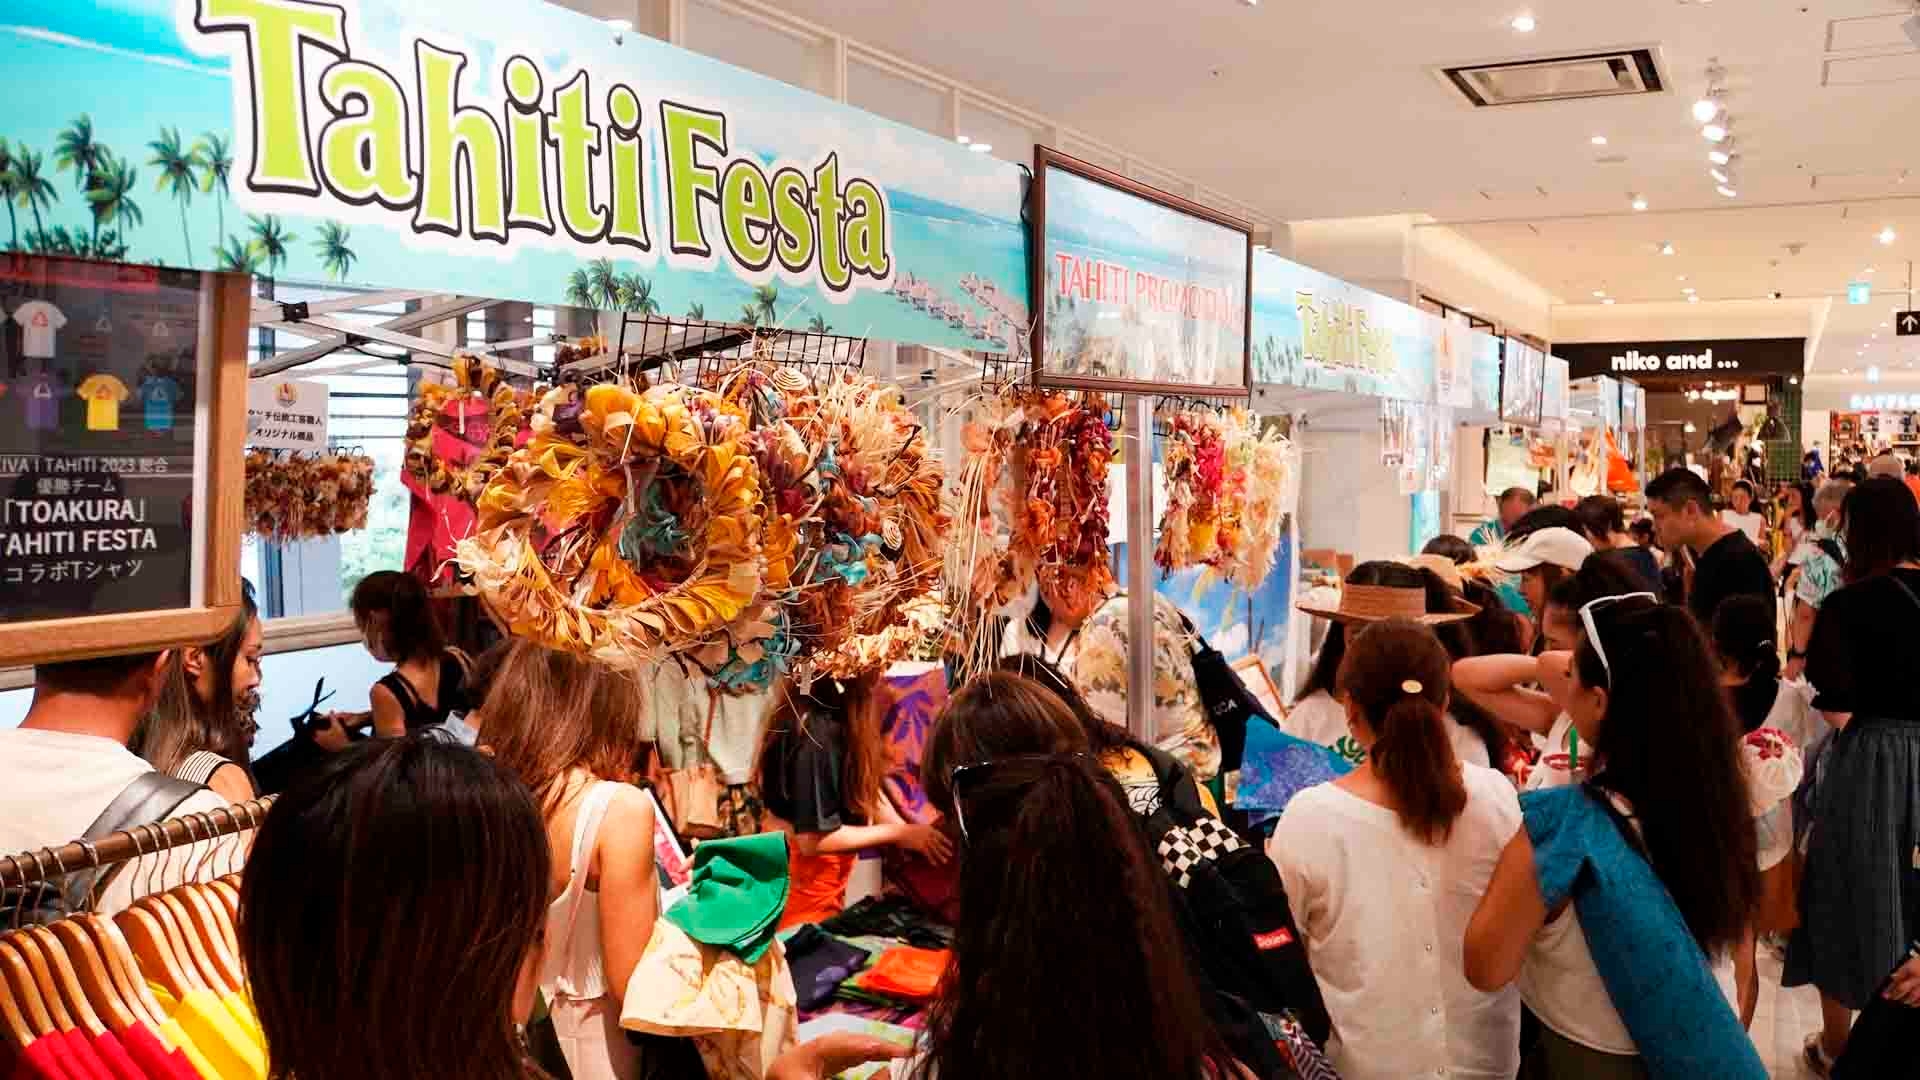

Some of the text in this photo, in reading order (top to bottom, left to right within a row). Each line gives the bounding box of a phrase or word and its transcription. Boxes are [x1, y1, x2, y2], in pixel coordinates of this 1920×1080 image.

[195, 0, 890, 291] Tahiti Festa
[1056, 254, 1129, 304] TAHITI
[1611, 350, 1661, 371] niko
[1666, 348, 1713, 370] and
[0, 457, 30, 473] IVA
[45, 457, 97, 473] TAHITI
[101, 457, 136, 473] 2023
[37, 477, 117, 496] 優勝チーム
[82, 527, 158, 553] FESTA
[5, 558, 144, 584] コラボTシャツ
